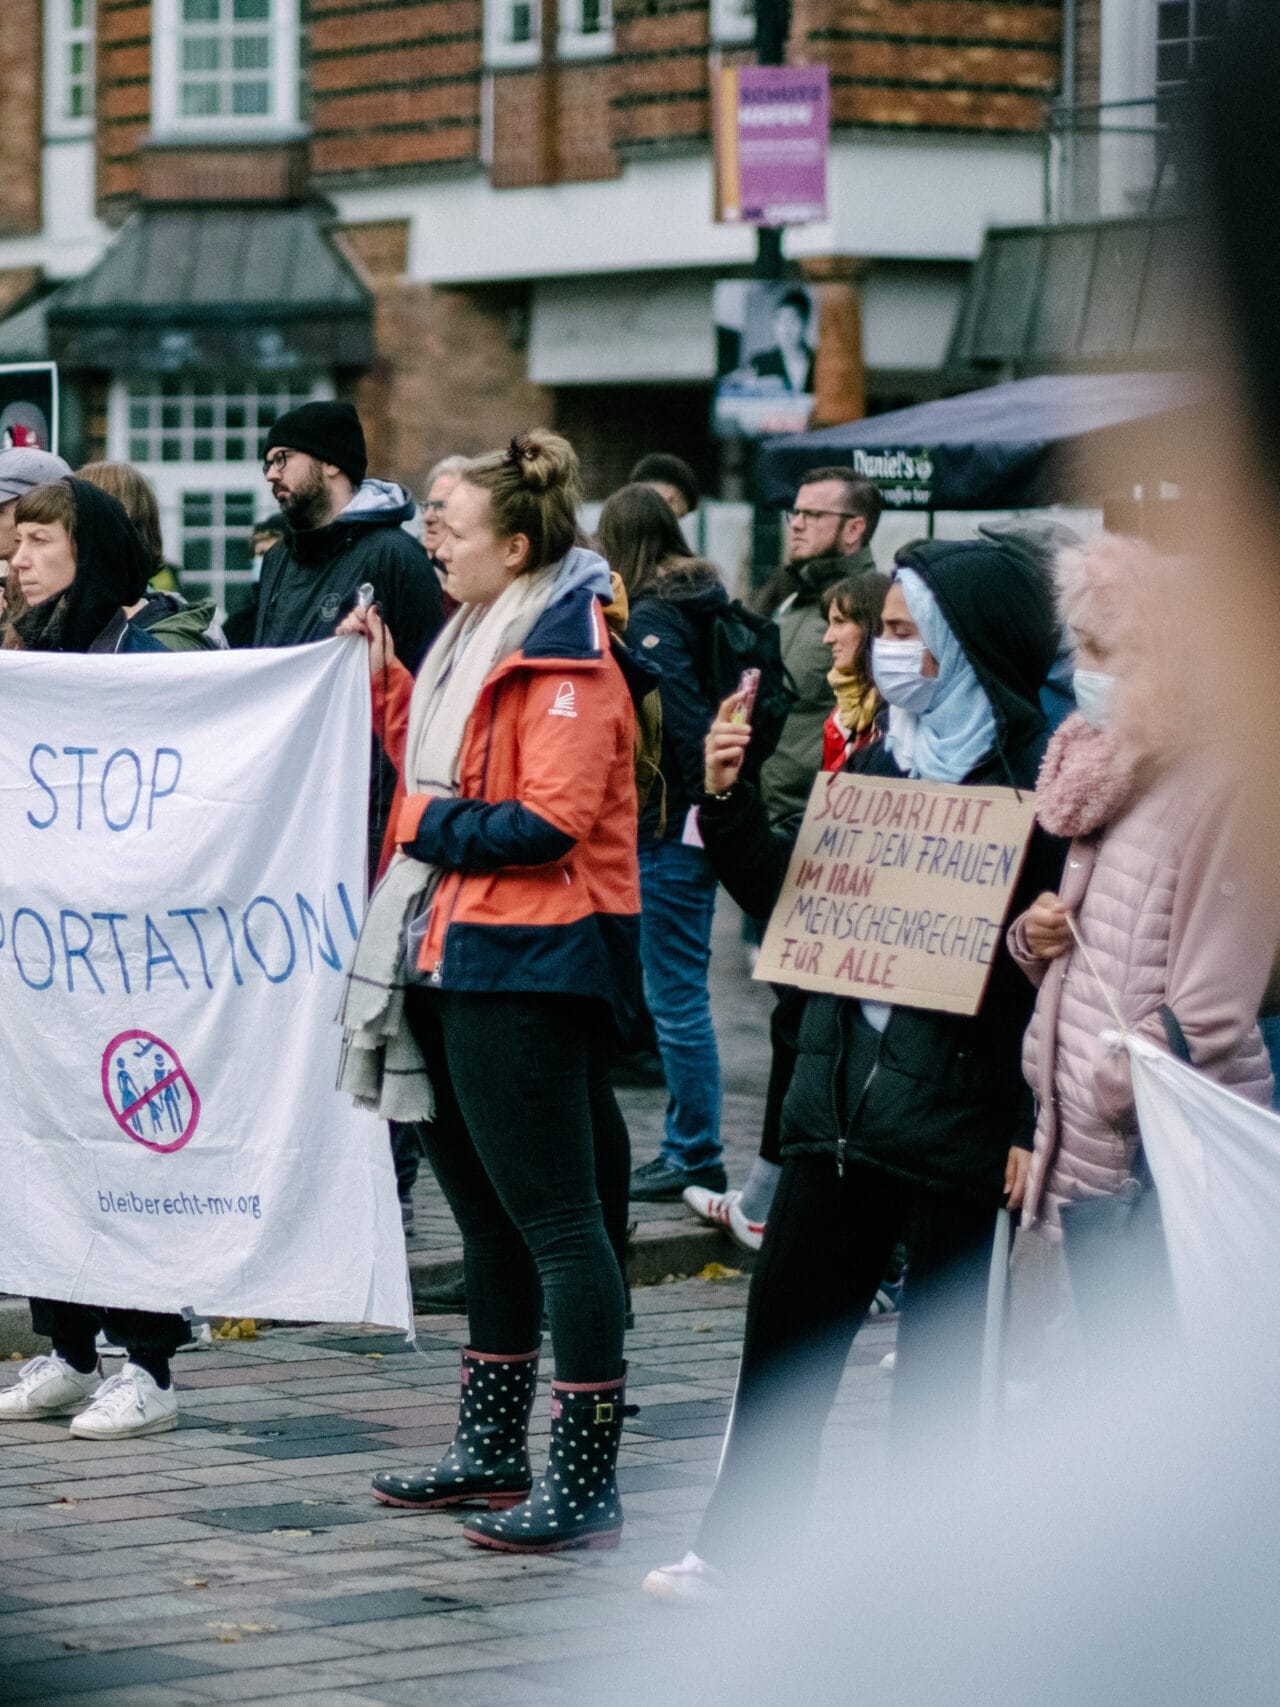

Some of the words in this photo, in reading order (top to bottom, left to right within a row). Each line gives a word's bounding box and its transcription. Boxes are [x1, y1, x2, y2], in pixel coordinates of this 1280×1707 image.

[26, 743, 183, 831] STOP
[795, 859, 824, 890] IM
[826, 863, 876, 897] IRAN
[815, 826, 862, 858] MIT
[866, 831, 915, 868] DEN
[916, 835, 1016, 887] FRAUEN
[784, 895, 1002, 965] MENSCHENRECHTE
[835, 946, 898, 989] ALLE
[97, 1190, 262, 1220] bleiberecht-mv.org
